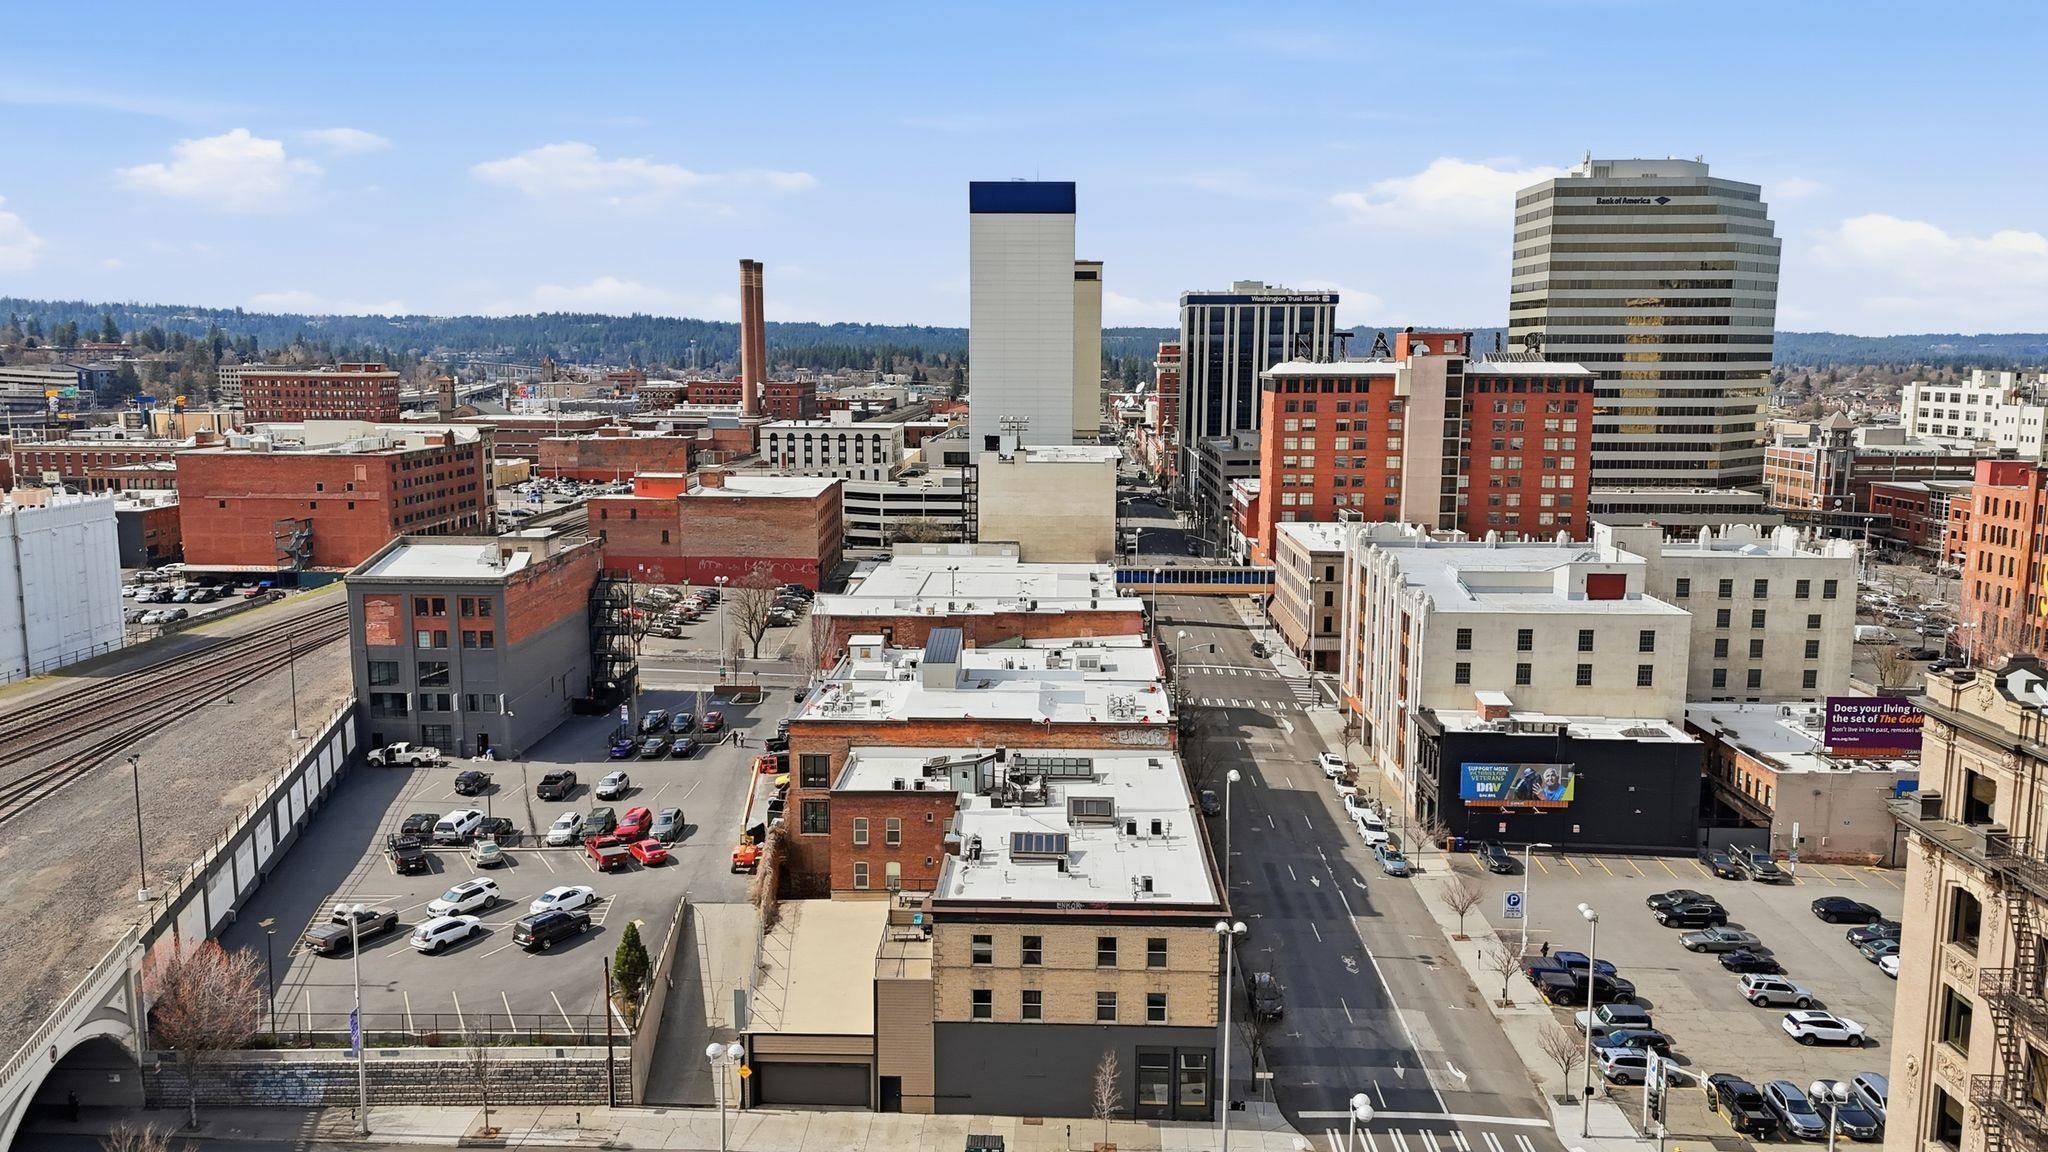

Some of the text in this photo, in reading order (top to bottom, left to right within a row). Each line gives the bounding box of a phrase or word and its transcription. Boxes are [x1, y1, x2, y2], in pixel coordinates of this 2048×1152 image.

[1251, 295, 1286, 304] Washington
[1834, 704, 1858, 713] Does
[1860, 706, 1883, 715] your
[1883, 704, 1911, 715] living
[1832, 714, 1925, 724] the set of The Gold
[1477, 783, 1502, 792] DAV
